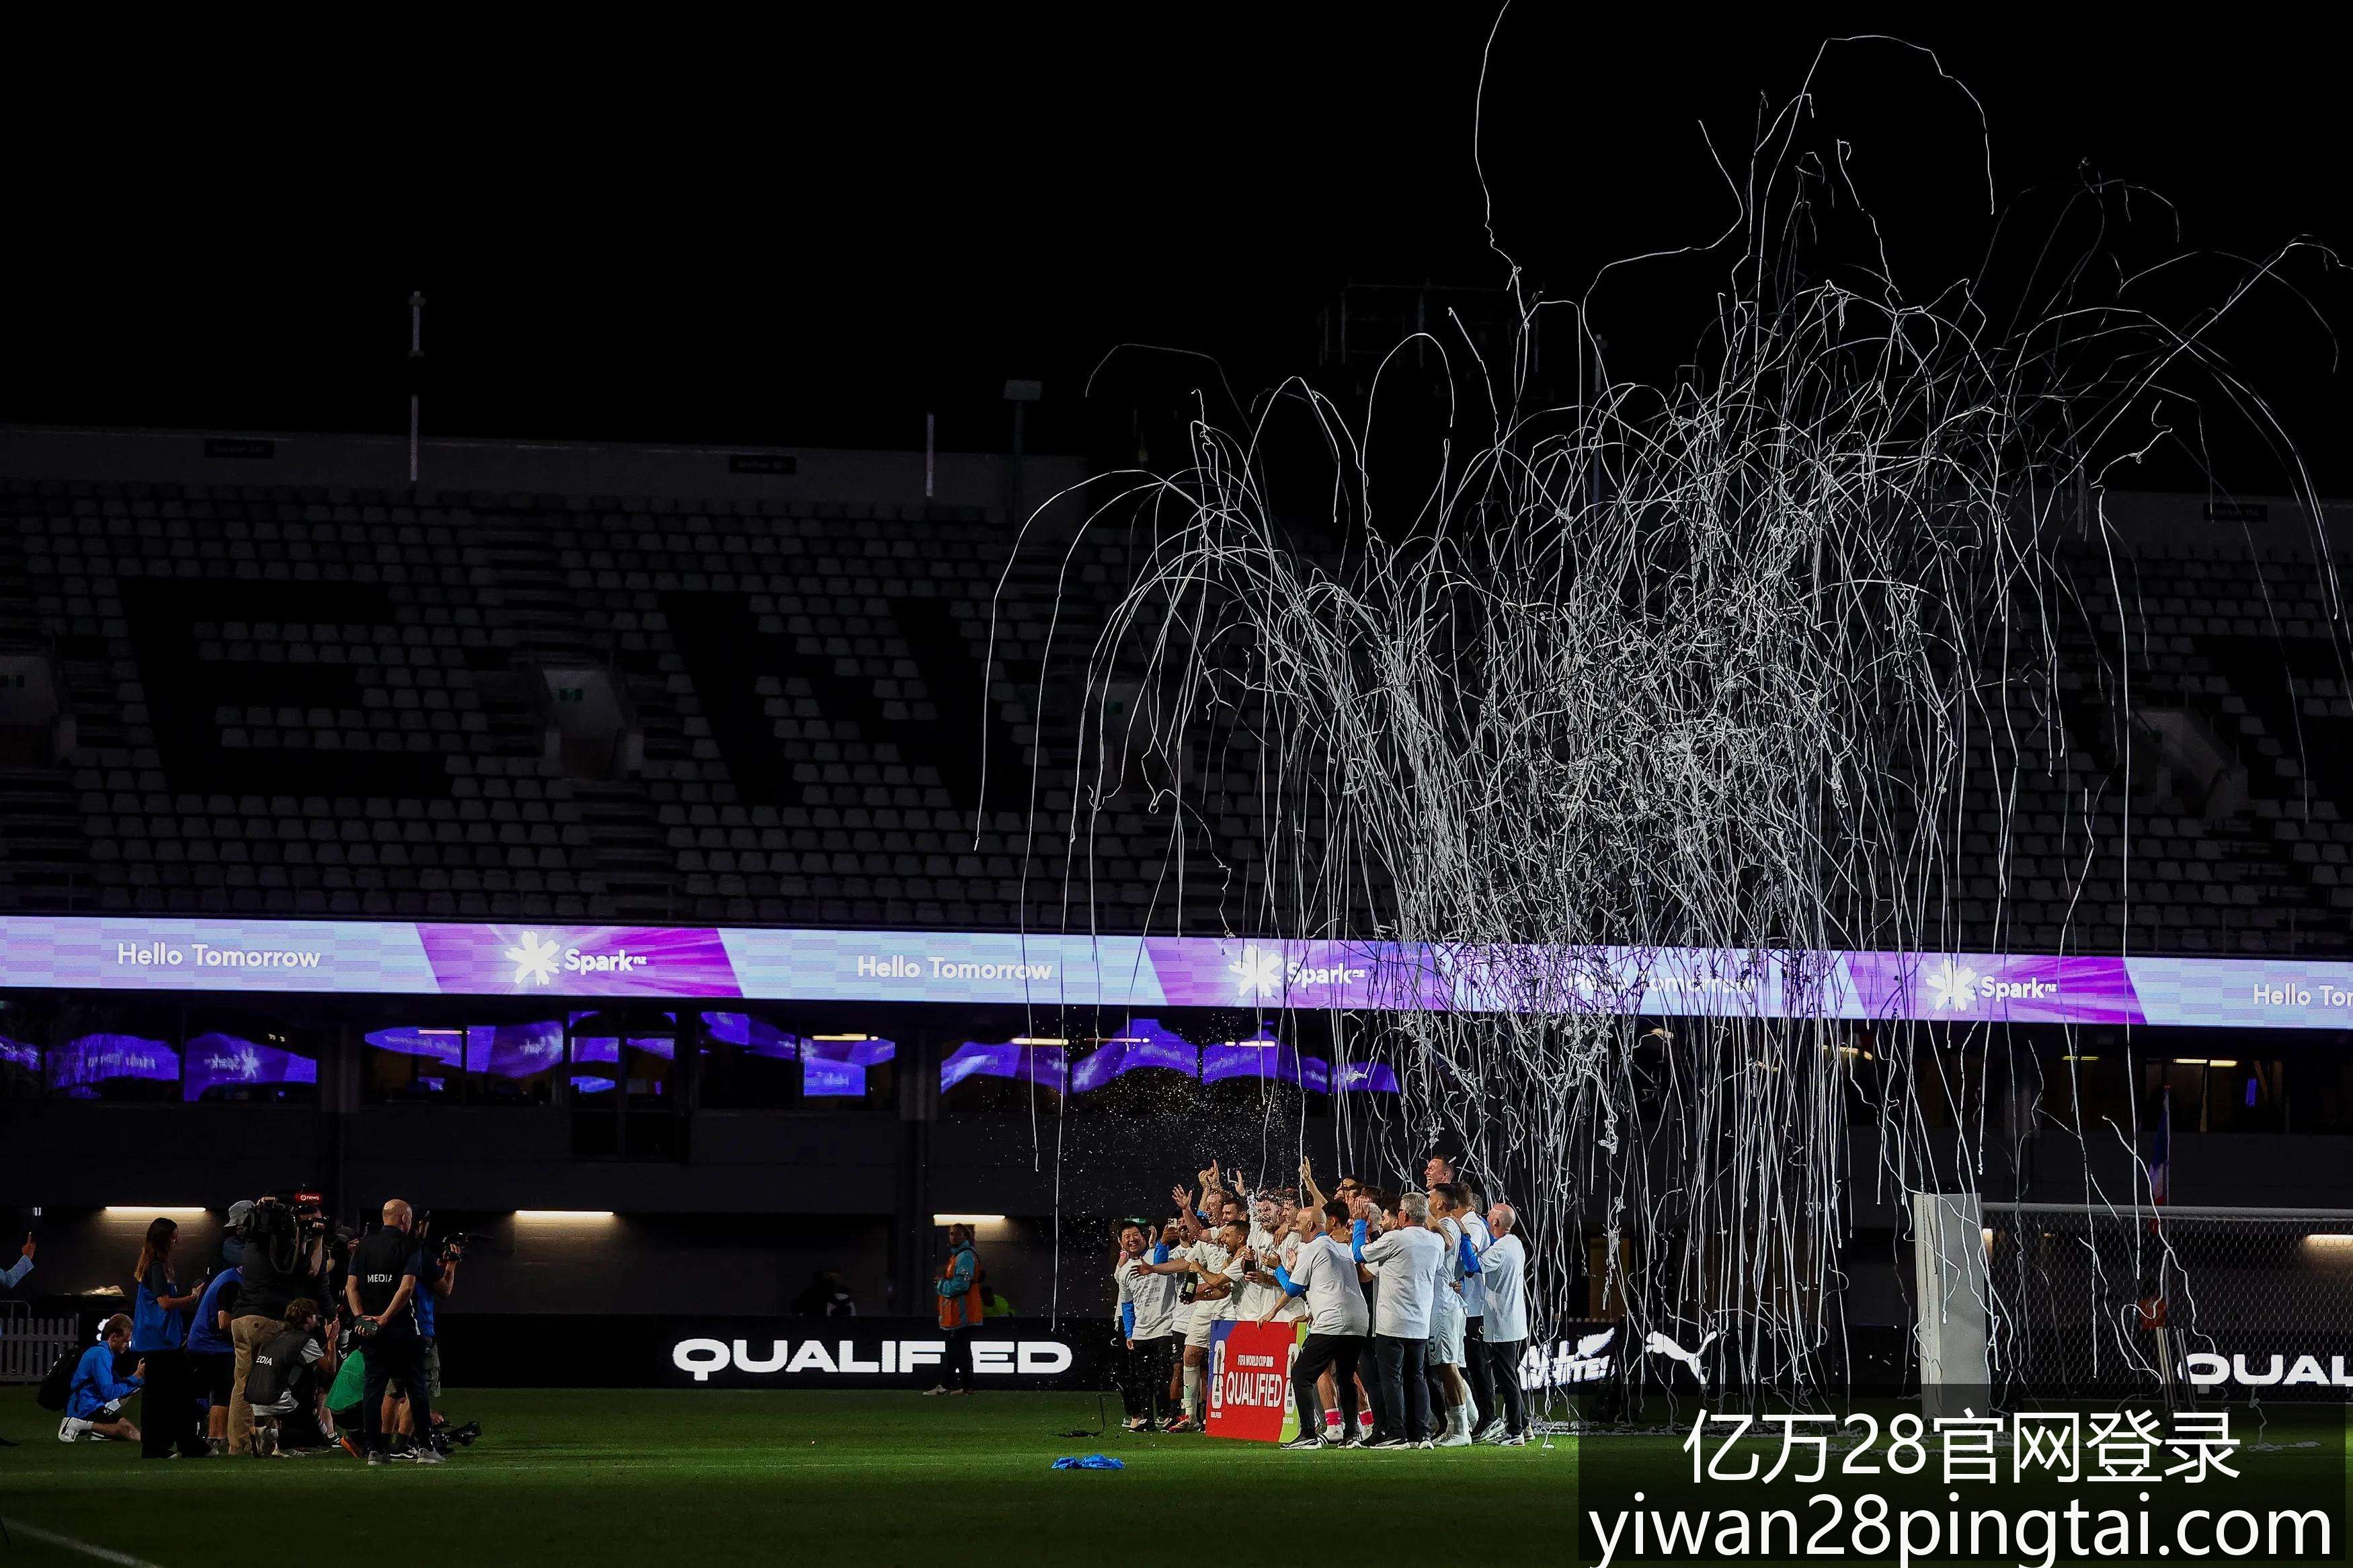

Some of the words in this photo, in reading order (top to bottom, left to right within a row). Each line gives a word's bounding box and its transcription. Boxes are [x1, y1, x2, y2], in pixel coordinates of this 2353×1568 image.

[117, 942, 182, 966] Hello
[192, 943, 321, 969] Tomorrow
[564, 948, 633, 975] Spark
[857, 955, 920, 979] Hello
[928, 956, 1052, 981] Tomorrow
[1285, 962, 1351, 987] Spark
[1981, 975, 2044, 1001] Spark
[2254, 983, 2311, 1005] Hello
[367, 1274, 393, 1283] MEDIA
[256, 1355, 272, 1366] EDIA
[672, 1338, 1073, 1381] QUALIFED
[1226, 1370, 1283, 1407] QUALIFIED
